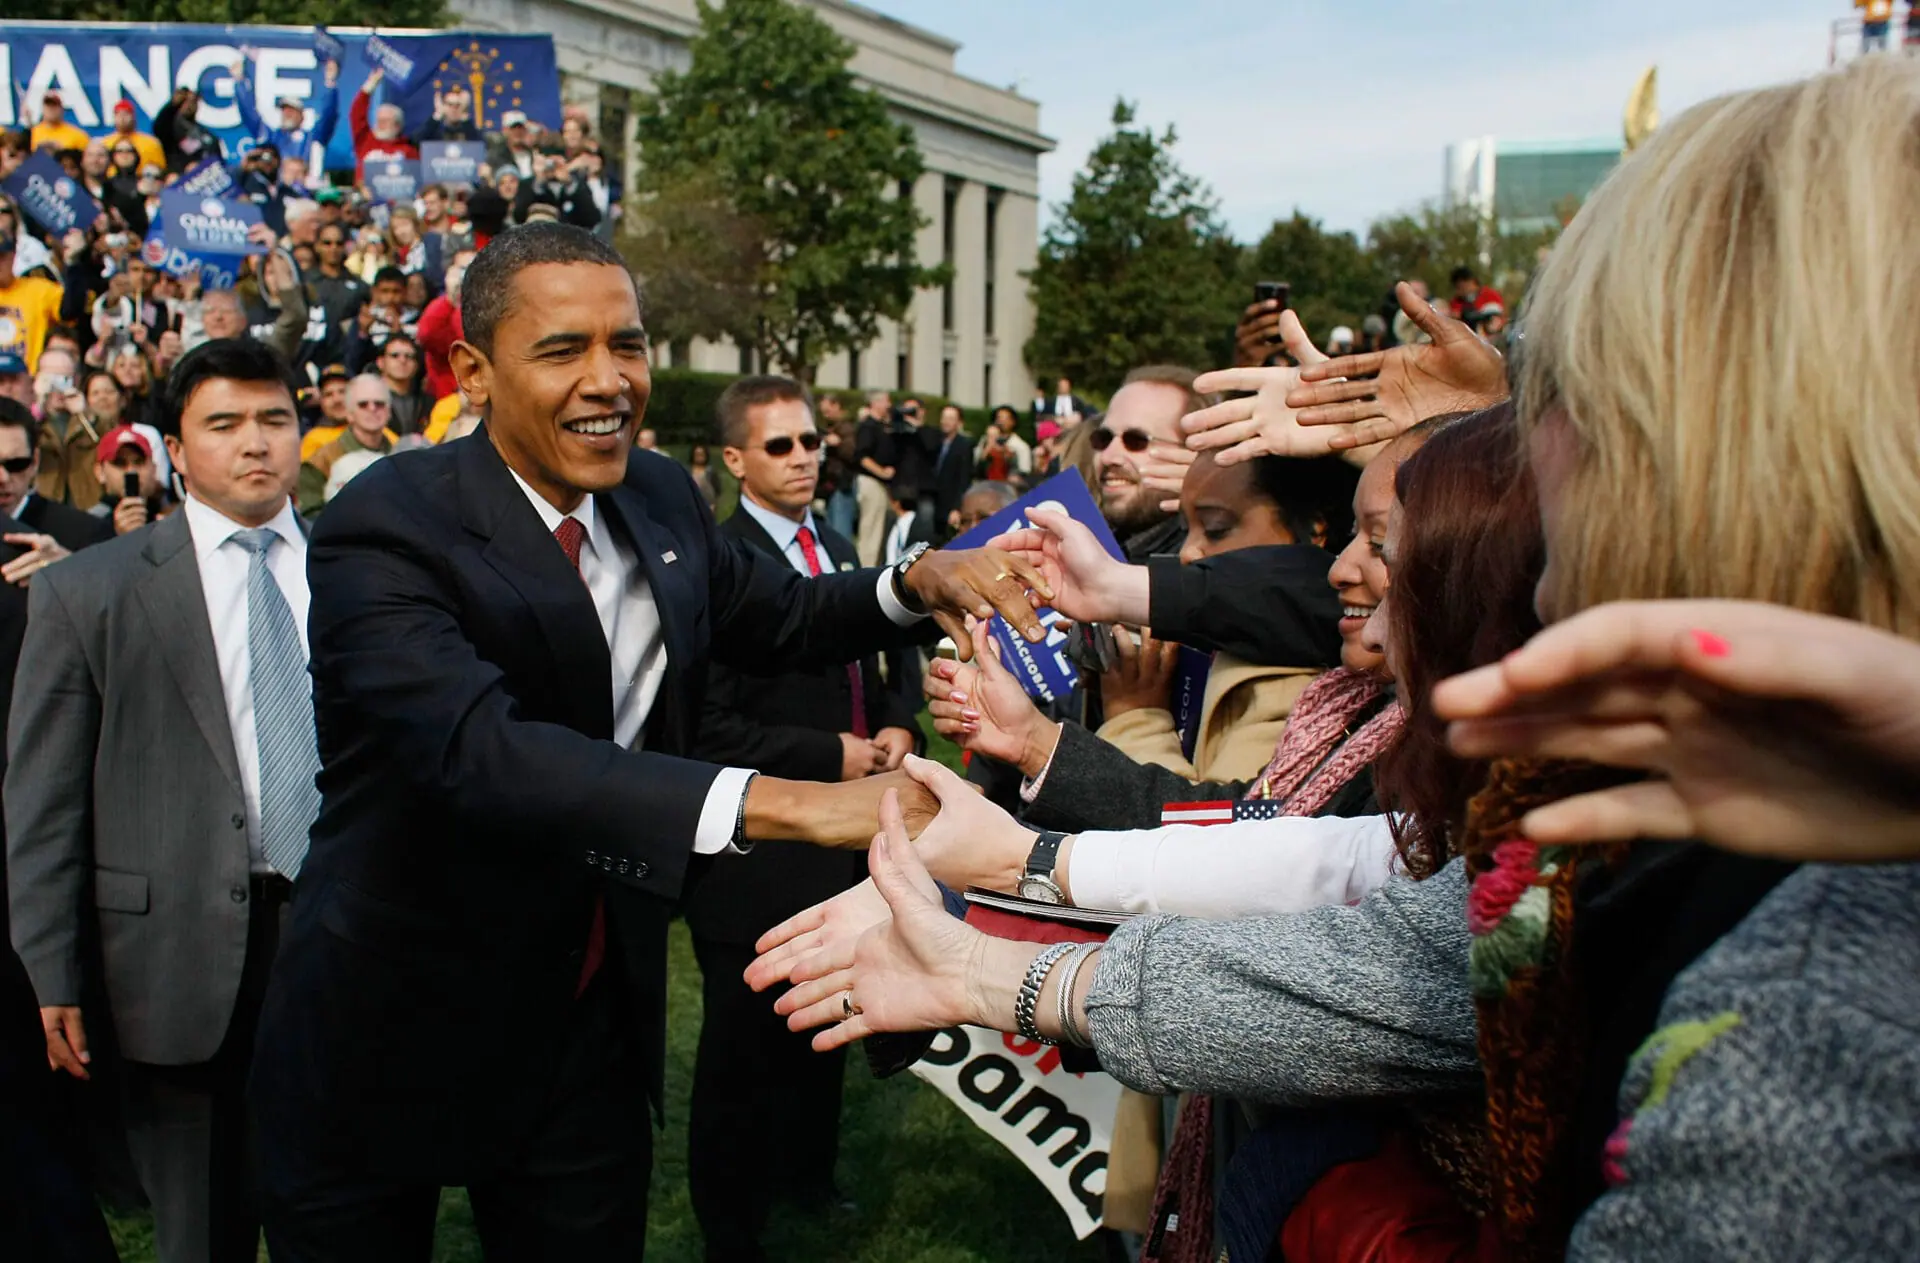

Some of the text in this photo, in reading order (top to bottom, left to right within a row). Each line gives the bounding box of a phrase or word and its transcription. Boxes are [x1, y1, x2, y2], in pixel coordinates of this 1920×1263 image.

[28, 174, 77, 226] OBAMA
[180, 213, 248, 234] OBAMA
[999, 614, 1055, 702] ARACKOBAM
